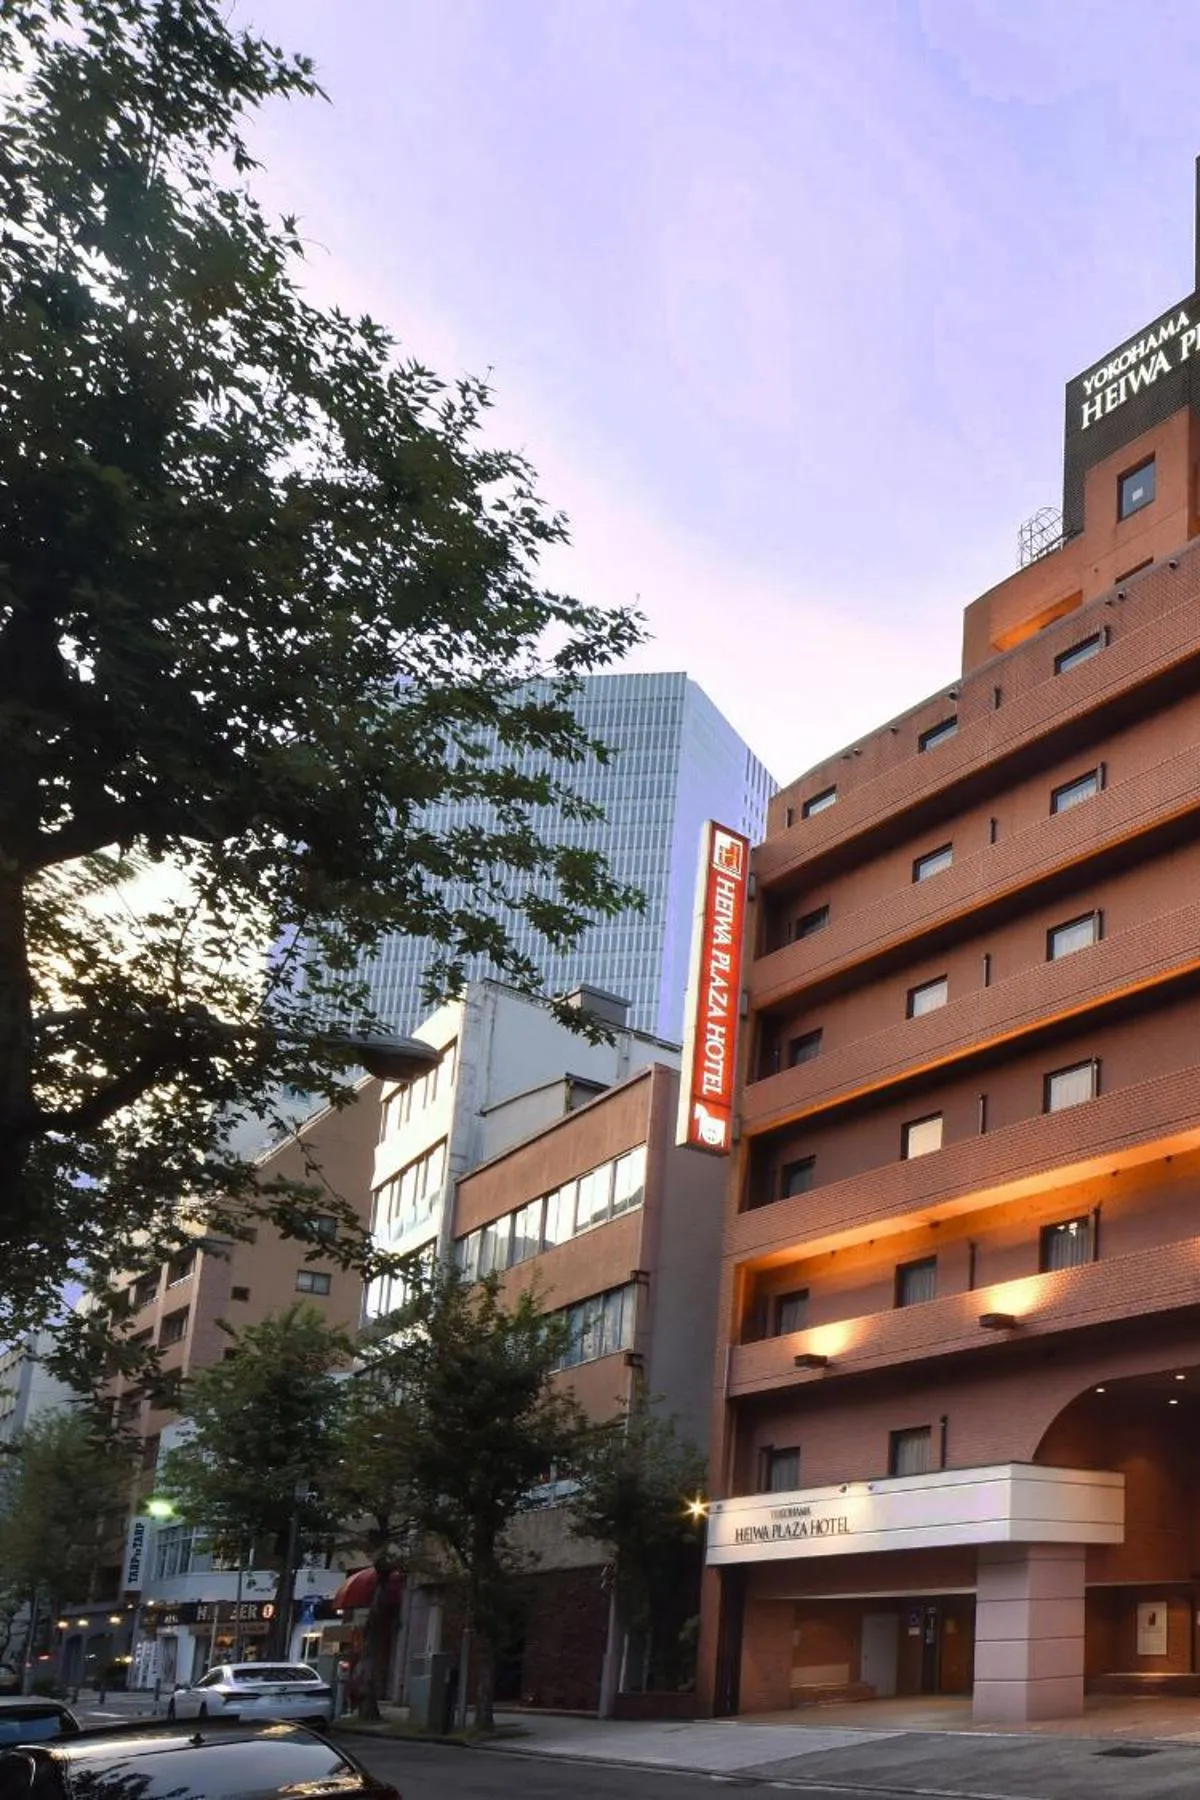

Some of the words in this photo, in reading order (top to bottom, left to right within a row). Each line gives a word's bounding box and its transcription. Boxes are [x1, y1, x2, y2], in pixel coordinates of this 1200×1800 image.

[1083, 311, 1190, 395] YOKOHAMA
[1080, 354, 1172, 430] HEIWA
[715, 876, 735, 944] HEIWA
[707, 949, 730, 1021] PLAZA
[702, 1022, 727, 1097] HOTEL
[735, 1525, 768, 1542] HEIWA
[772, 1522, 807, 1538] PLAZA
[811, 1517, 849, 1535] HOTEL
